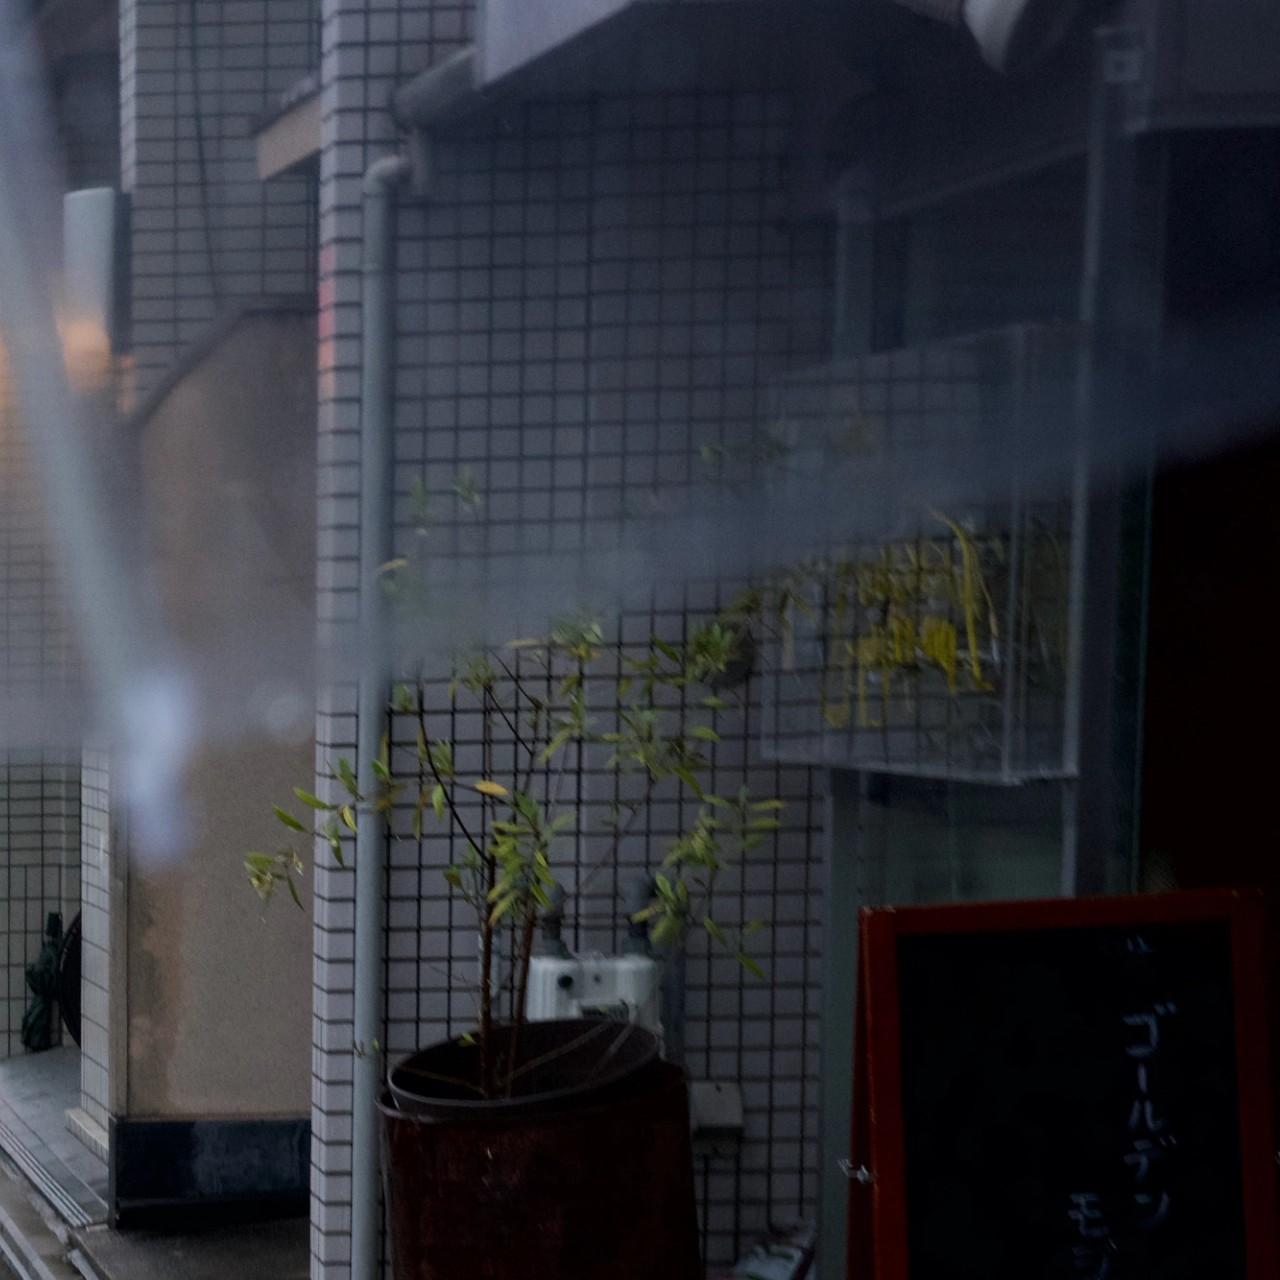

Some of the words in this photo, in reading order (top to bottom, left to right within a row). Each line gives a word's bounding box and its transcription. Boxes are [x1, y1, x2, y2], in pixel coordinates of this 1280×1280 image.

[1120, 998, 1179, 1227] ゴールデン
